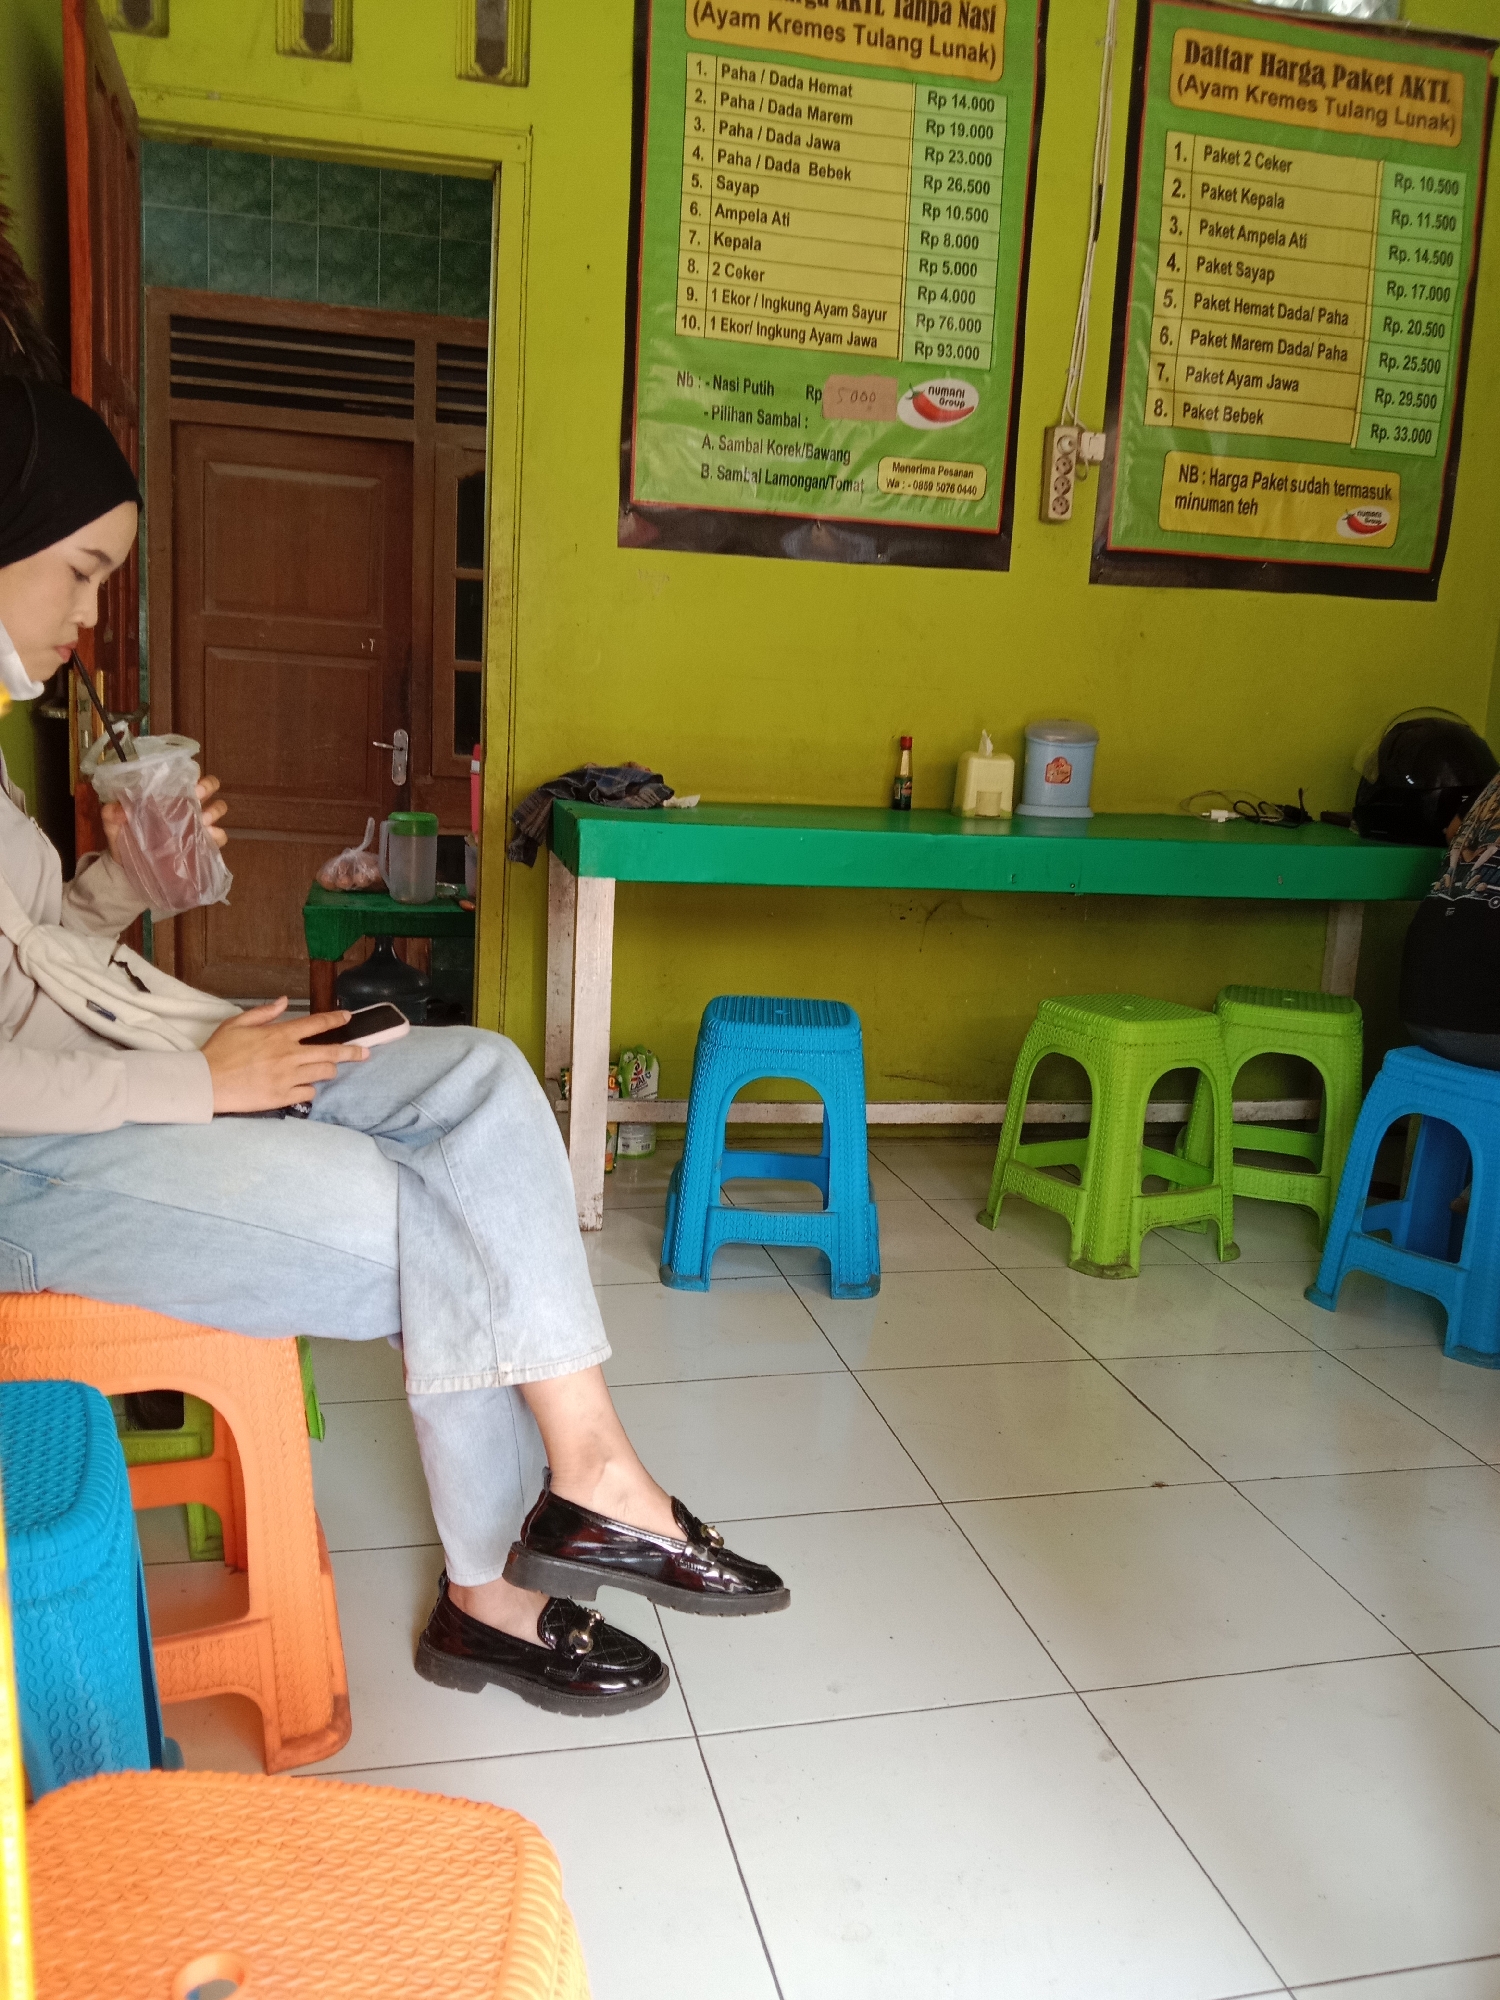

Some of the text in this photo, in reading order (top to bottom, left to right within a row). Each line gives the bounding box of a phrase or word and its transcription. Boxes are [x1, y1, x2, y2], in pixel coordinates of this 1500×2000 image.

[694, 0, 996, 70] (Ayam Kremes Tulang Lunak)
[894, 0, 952, 27] Tanpa
[958, 0, 996, 33] Nasi
[697, 60, 994, 112] 1. Paha Dada Hemat Rp 14.000
[1184, 40, 1253, 74] Daftar
[1260, 52, 1326, 90] Harga
[1332, 64, 1393, 96] Paket
[695, 88, 993, 139] 2. Paha Dada Marem Rp 19.000
[1178, 74, 1455, 137] (Ayam Kremes Tulang Lunak)
[694, 116, 992, 167] 3. Paha Dada Jawa Rp 23.000
[692, 145, 990, 195] 4. Paha Dada Bebek Rp 26.500
[1175, 141, 1458, 196] 1. Paket 2 Ceker Rp. 10.500
[692, 173, 988, 223] 5. Sayap Rp 10.500
[1172, 178, 1456, 231] 2. Paket Kepala Rp. 11.500
[690, 201, 979, 250] 6. Ampela Ati Rp 8.000
[1170, 215, 1453, 267] 3. Paket Ampela Ati Rp. 14.500
[689, 230, 977, 277] 7. Kepala Rp 5.000
[1166, 252, 1450, 302] 4. Paket Sayap Rp. 17.000
[688, 258, 975, 305] 8. 2 Ceker Rp 4.000
[687, 286, 982, 333] 9. 1 Ekor Ingkung Ayam Sayur Rp 76.000
[1163, 288, 1176, 308] 5.
[1194, 292, 1230, 312] Paket
[1234, 298, 1274, 318] Hemat
[1318, 307, 1349, 326] Paha
[1383, 316, 1403, 337] Rp.
[1407, 319, 1445, 338] 20.500
[682, 314, 700, 330] 10.
[711, 316, 715, 330] 1
[757, 321, 806, 344] Ingkung
[809, 327, 842, 346] Ayam
[847, 331, 877, 348] Jawa
[915, 341, 933, 360] Rp
[937, 343, 980, 360] 93.000
[1160, 326, 1172, 346] 6.
[1190, 329, 1227, 348] Paket
[1231, 333, 1273, 354] Marem
[1318, 343, 1348, 362] Paha
[1379, 352, 1399, 373] Rp.
[1403, 355, 1441, 374] 25.500
[677, 370, 822, 405] Nb Nasi Putih Rp
[940, 398, 965, 409] Group
[1157, 362, 1437, 409] 7. Paket Ayam Jawa Rp. 29.500
[712, 405, 800, 428] Pilihan Sambal
[1154, 398, 1432, 444] 8. Paket Bebek Rp. 33.000
[702, 434, 850, 466] A. Sambal Korek/Bawang
[892, 462, 973, 478] Menerima Pesanan
[701, 463, 864, 495] B. Sambal Lamongan/Tomat
[1179, 464, 1392, 500] NB Harga Paket sudah termasuk
[1175, 492, 1258, 516] minuman teh
